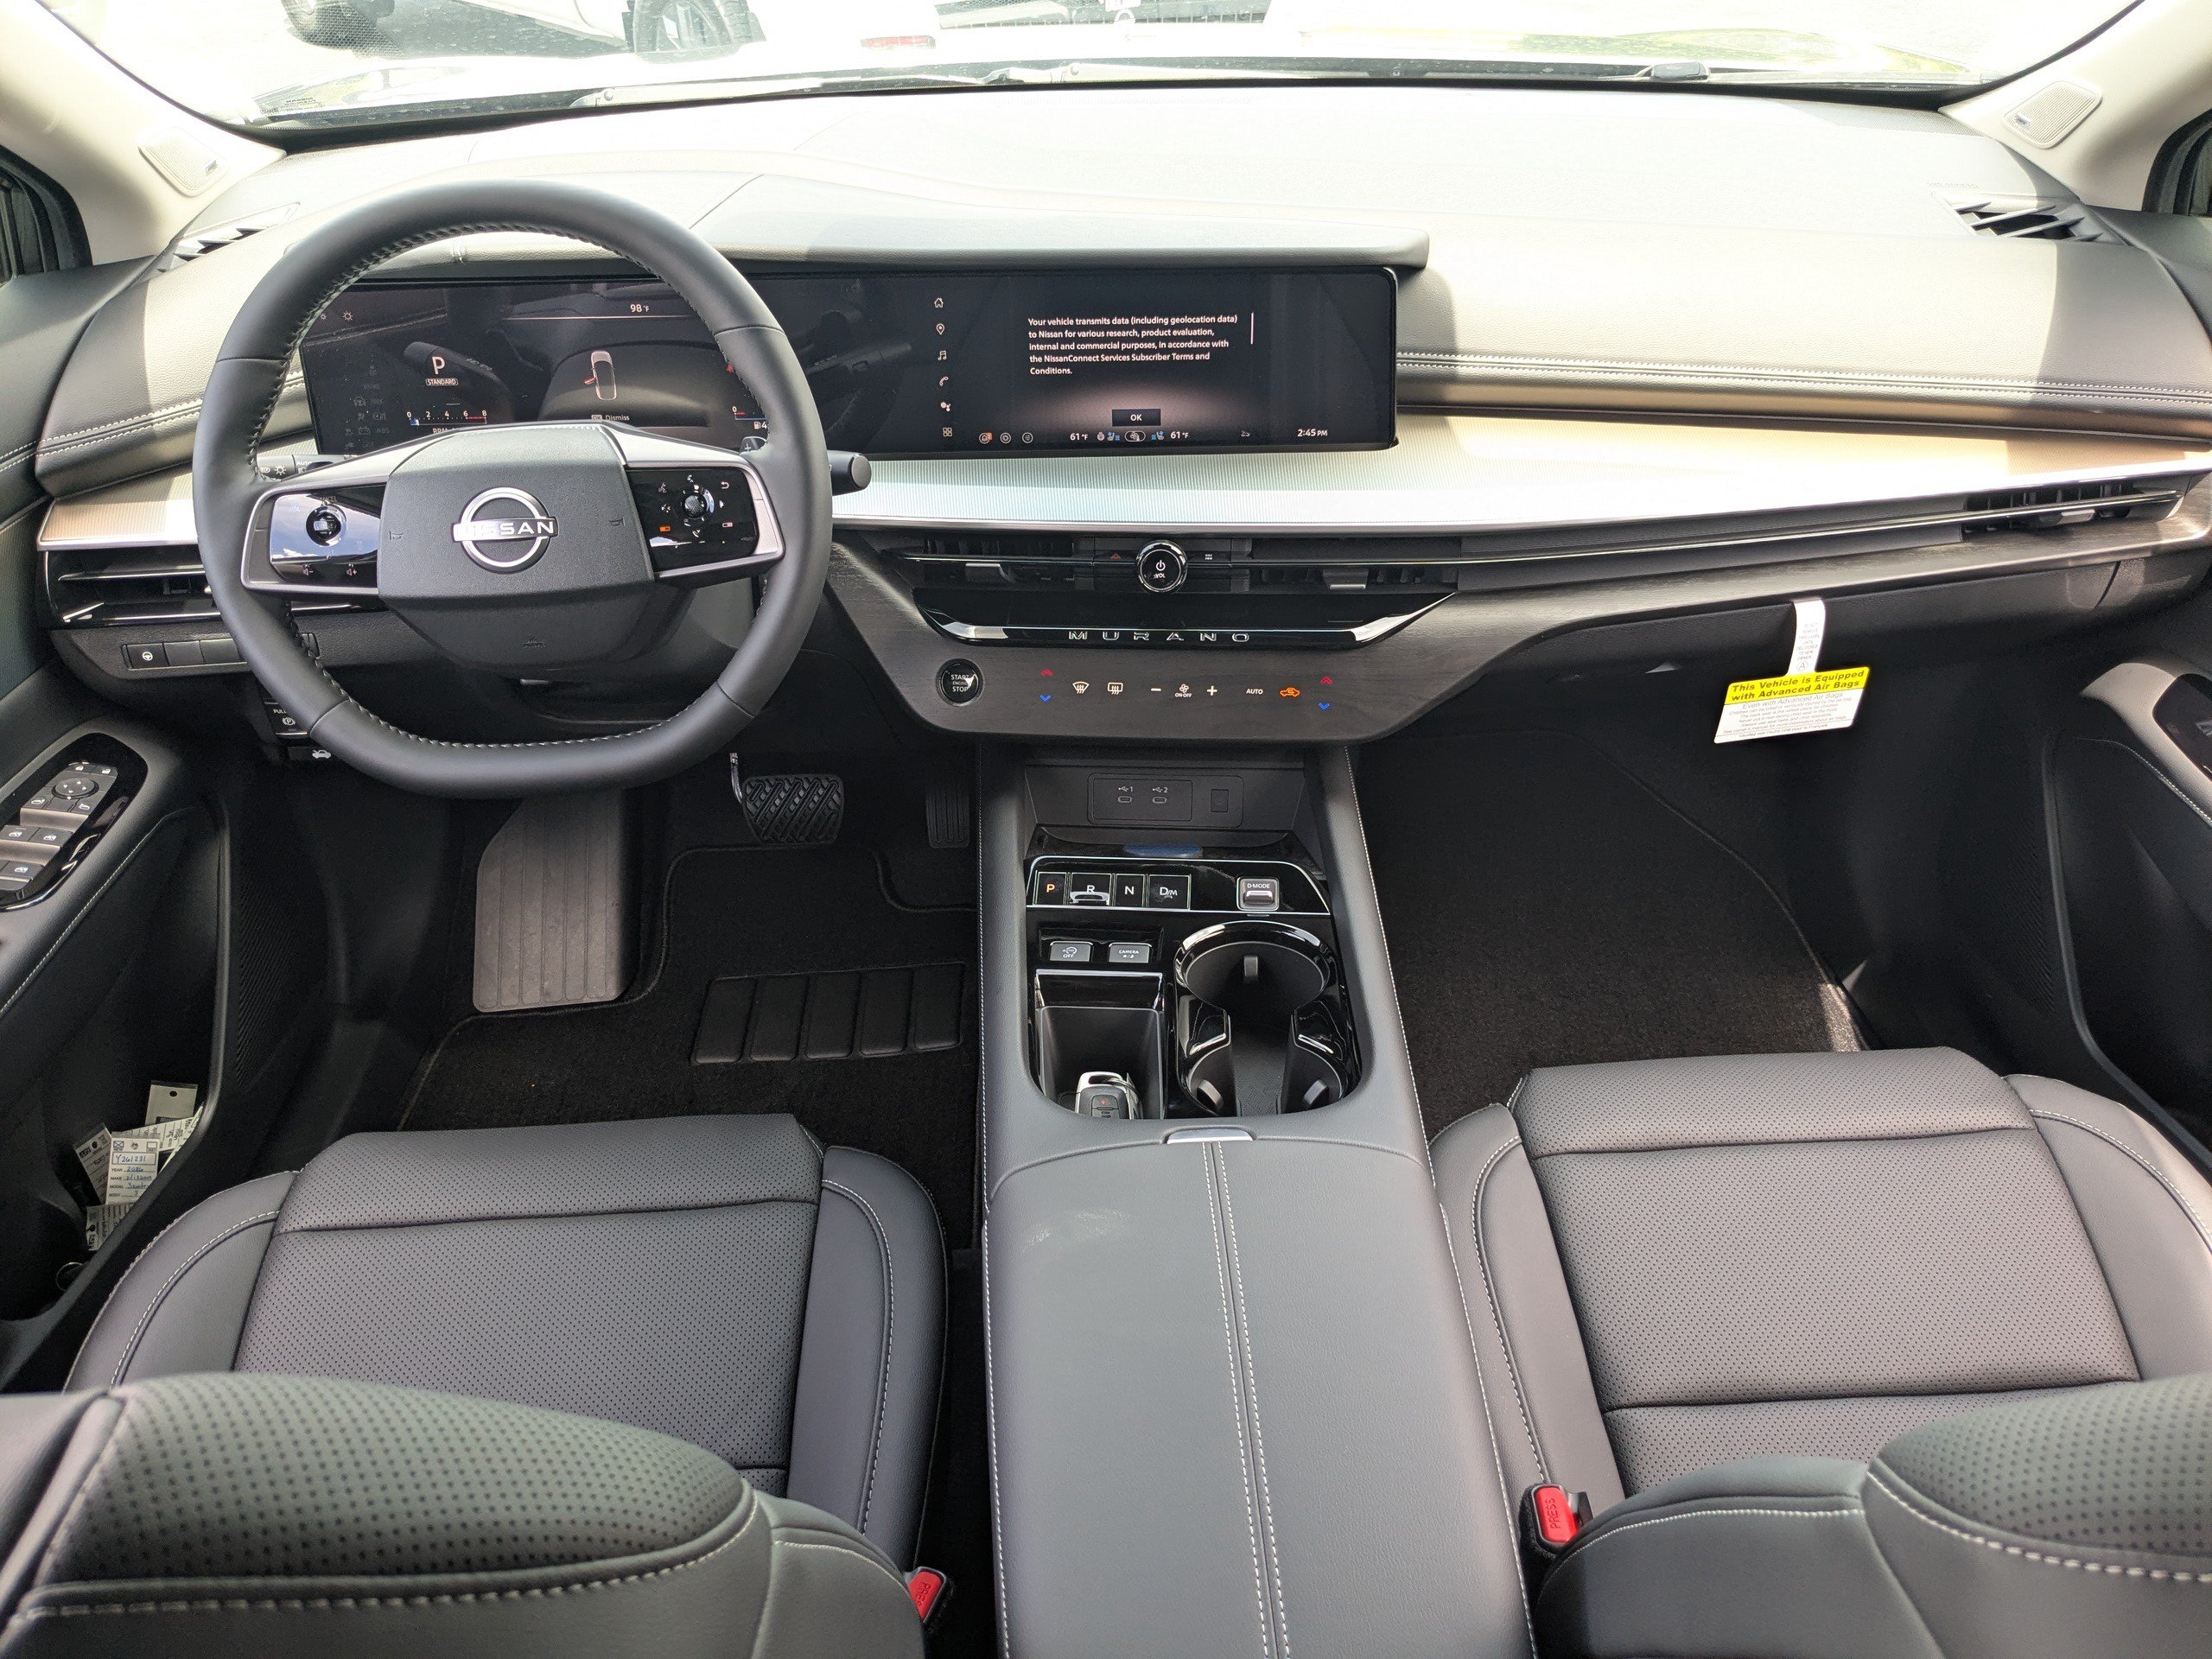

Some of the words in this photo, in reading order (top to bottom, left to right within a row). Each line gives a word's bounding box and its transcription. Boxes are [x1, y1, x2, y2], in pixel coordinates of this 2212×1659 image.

[630, 304, 642, 313] 98
[1047, 317, 1073, 326] vehicle
[1076, 316, 1111, 325] transmits
[1112, 316, 1129, 325] data
[1131, 316, 1168, 327] (including
[1170, 315, 1216, 326] geolocation
[1217, 315, 1237, 325] data)
[1029, 330, 1038, 339] to
[1039, 330, 1063, 339] Nissan
[1065, 329, 1077, 338] for
[1106, 329, 1141, 339] research,
[1141, 328, 1171, 339] product
[1173, 328, 1215, 337] evaluation,
[1077, 341, 1120, 350] commercial
[1122, 342, 1158, 351] purposes,
[1168, 340, 1210, 349] accordance
[1030, 354, 1042, 363] the
[1132, 353, 1170, 361] Subscriber
[1172, 353, 1194, 361] Terms
[431, 356, 446, 374] P
[1170, 430, 1180, 439] 61
[1298, 429, 1316, 437] 2:45
[456, 521, 554, 539] ISSAN
[1068, 631, 1249, 643] MURANO
[1733, 683, 1756, 693] This
[1759, 677, 1798, 689] Vehicle
[1815, 671, 1865, 683] Equipped
[1732, 691, 1756, 702] with
[1758, 685, 1811, 697] Advanced
[1815, 683, 1830, 691] Air
[1834, 679, 1859, 689] Bags
[1777, 695, 1812, 705] Advanced
[1046, 883, 1056, 893] P
[1087, 885, 1096, 893] R
[1125, 886, 1135, 895] N
[1545, 1497, 1560, 1529] PRESS
